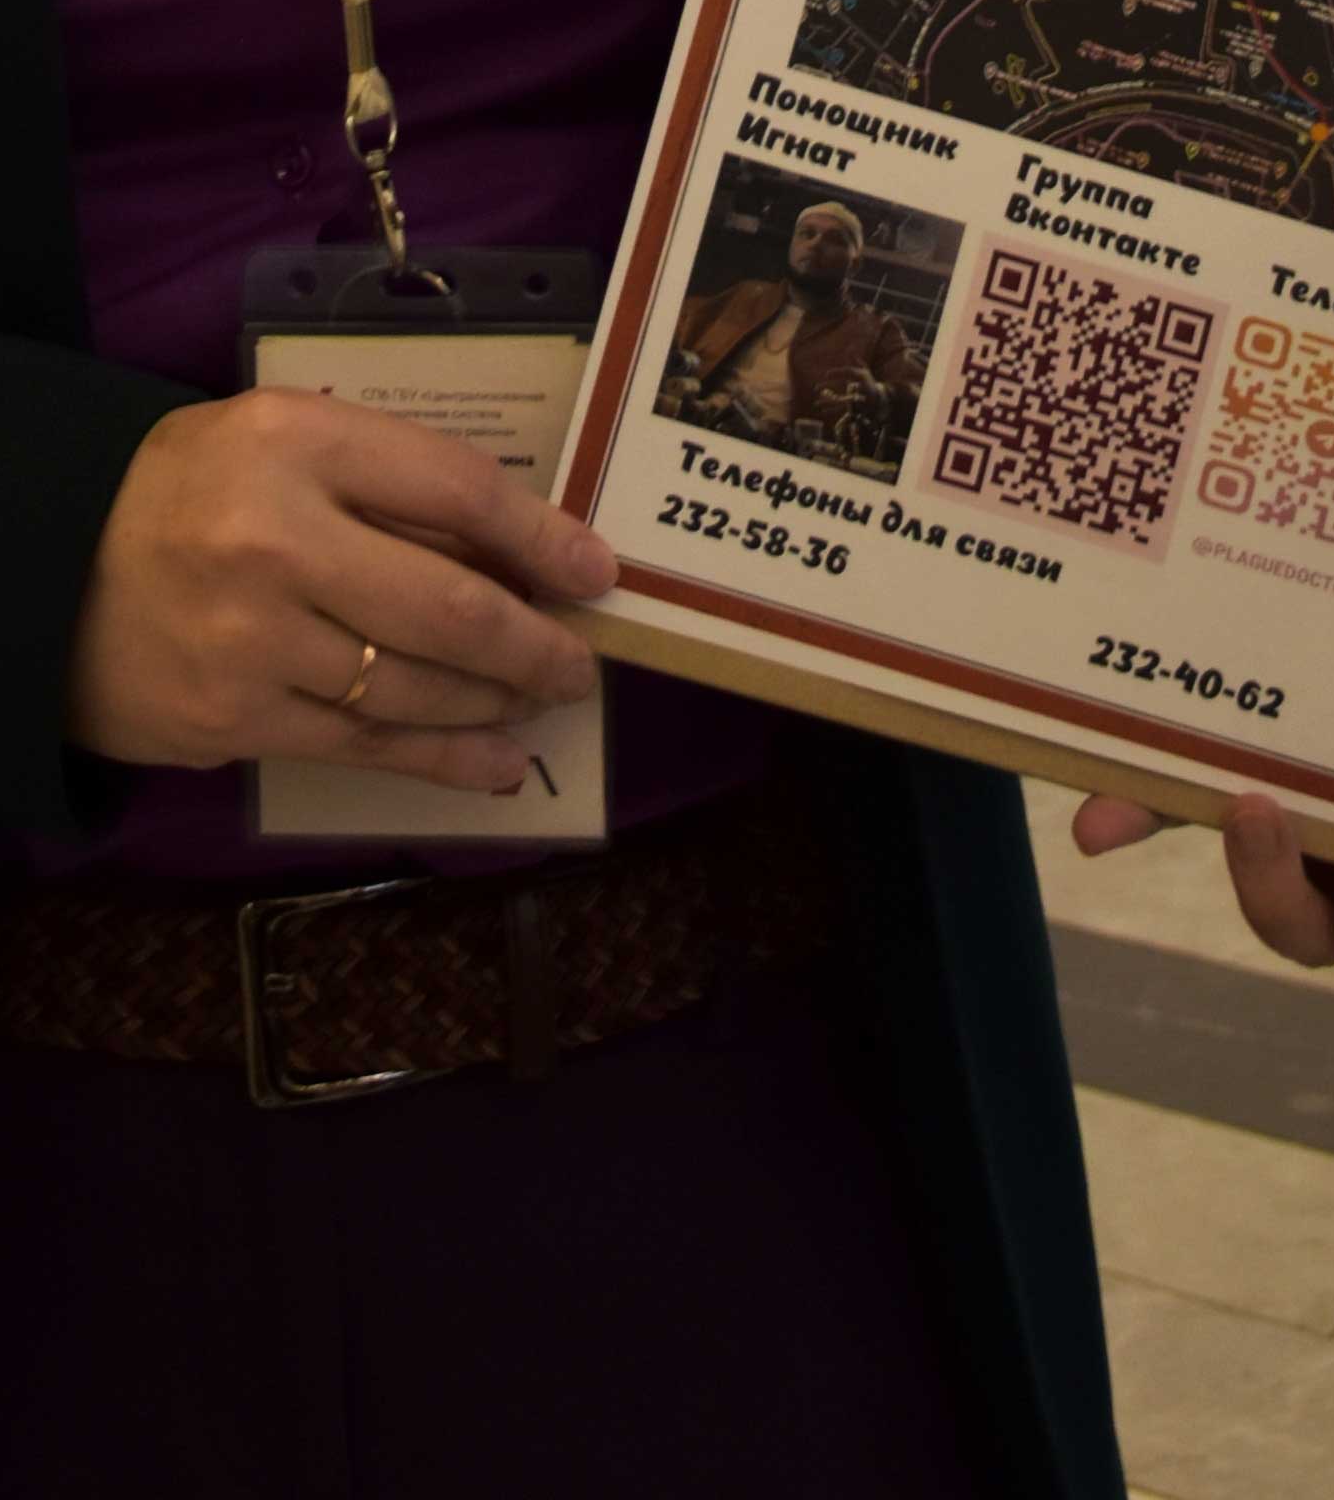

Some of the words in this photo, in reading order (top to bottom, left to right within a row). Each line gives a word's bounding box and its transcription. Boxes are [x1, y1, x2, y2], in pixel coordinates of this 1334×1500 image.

[736, 112, 856, 173] Игнат
[748, 72, 959, 161] Помощник
[1015, 153, 1154, 220] Группа
[1004, 192, 1201, 277] Вконтакте
[656, 494, 851, 576] 232-58-36
[679, 440, 873, 527] Телефоны
[880, 499, 948, 549] для
[955, 533, 1063, 584] связи
[1087, 635, 1286, 720] 232-40-62
